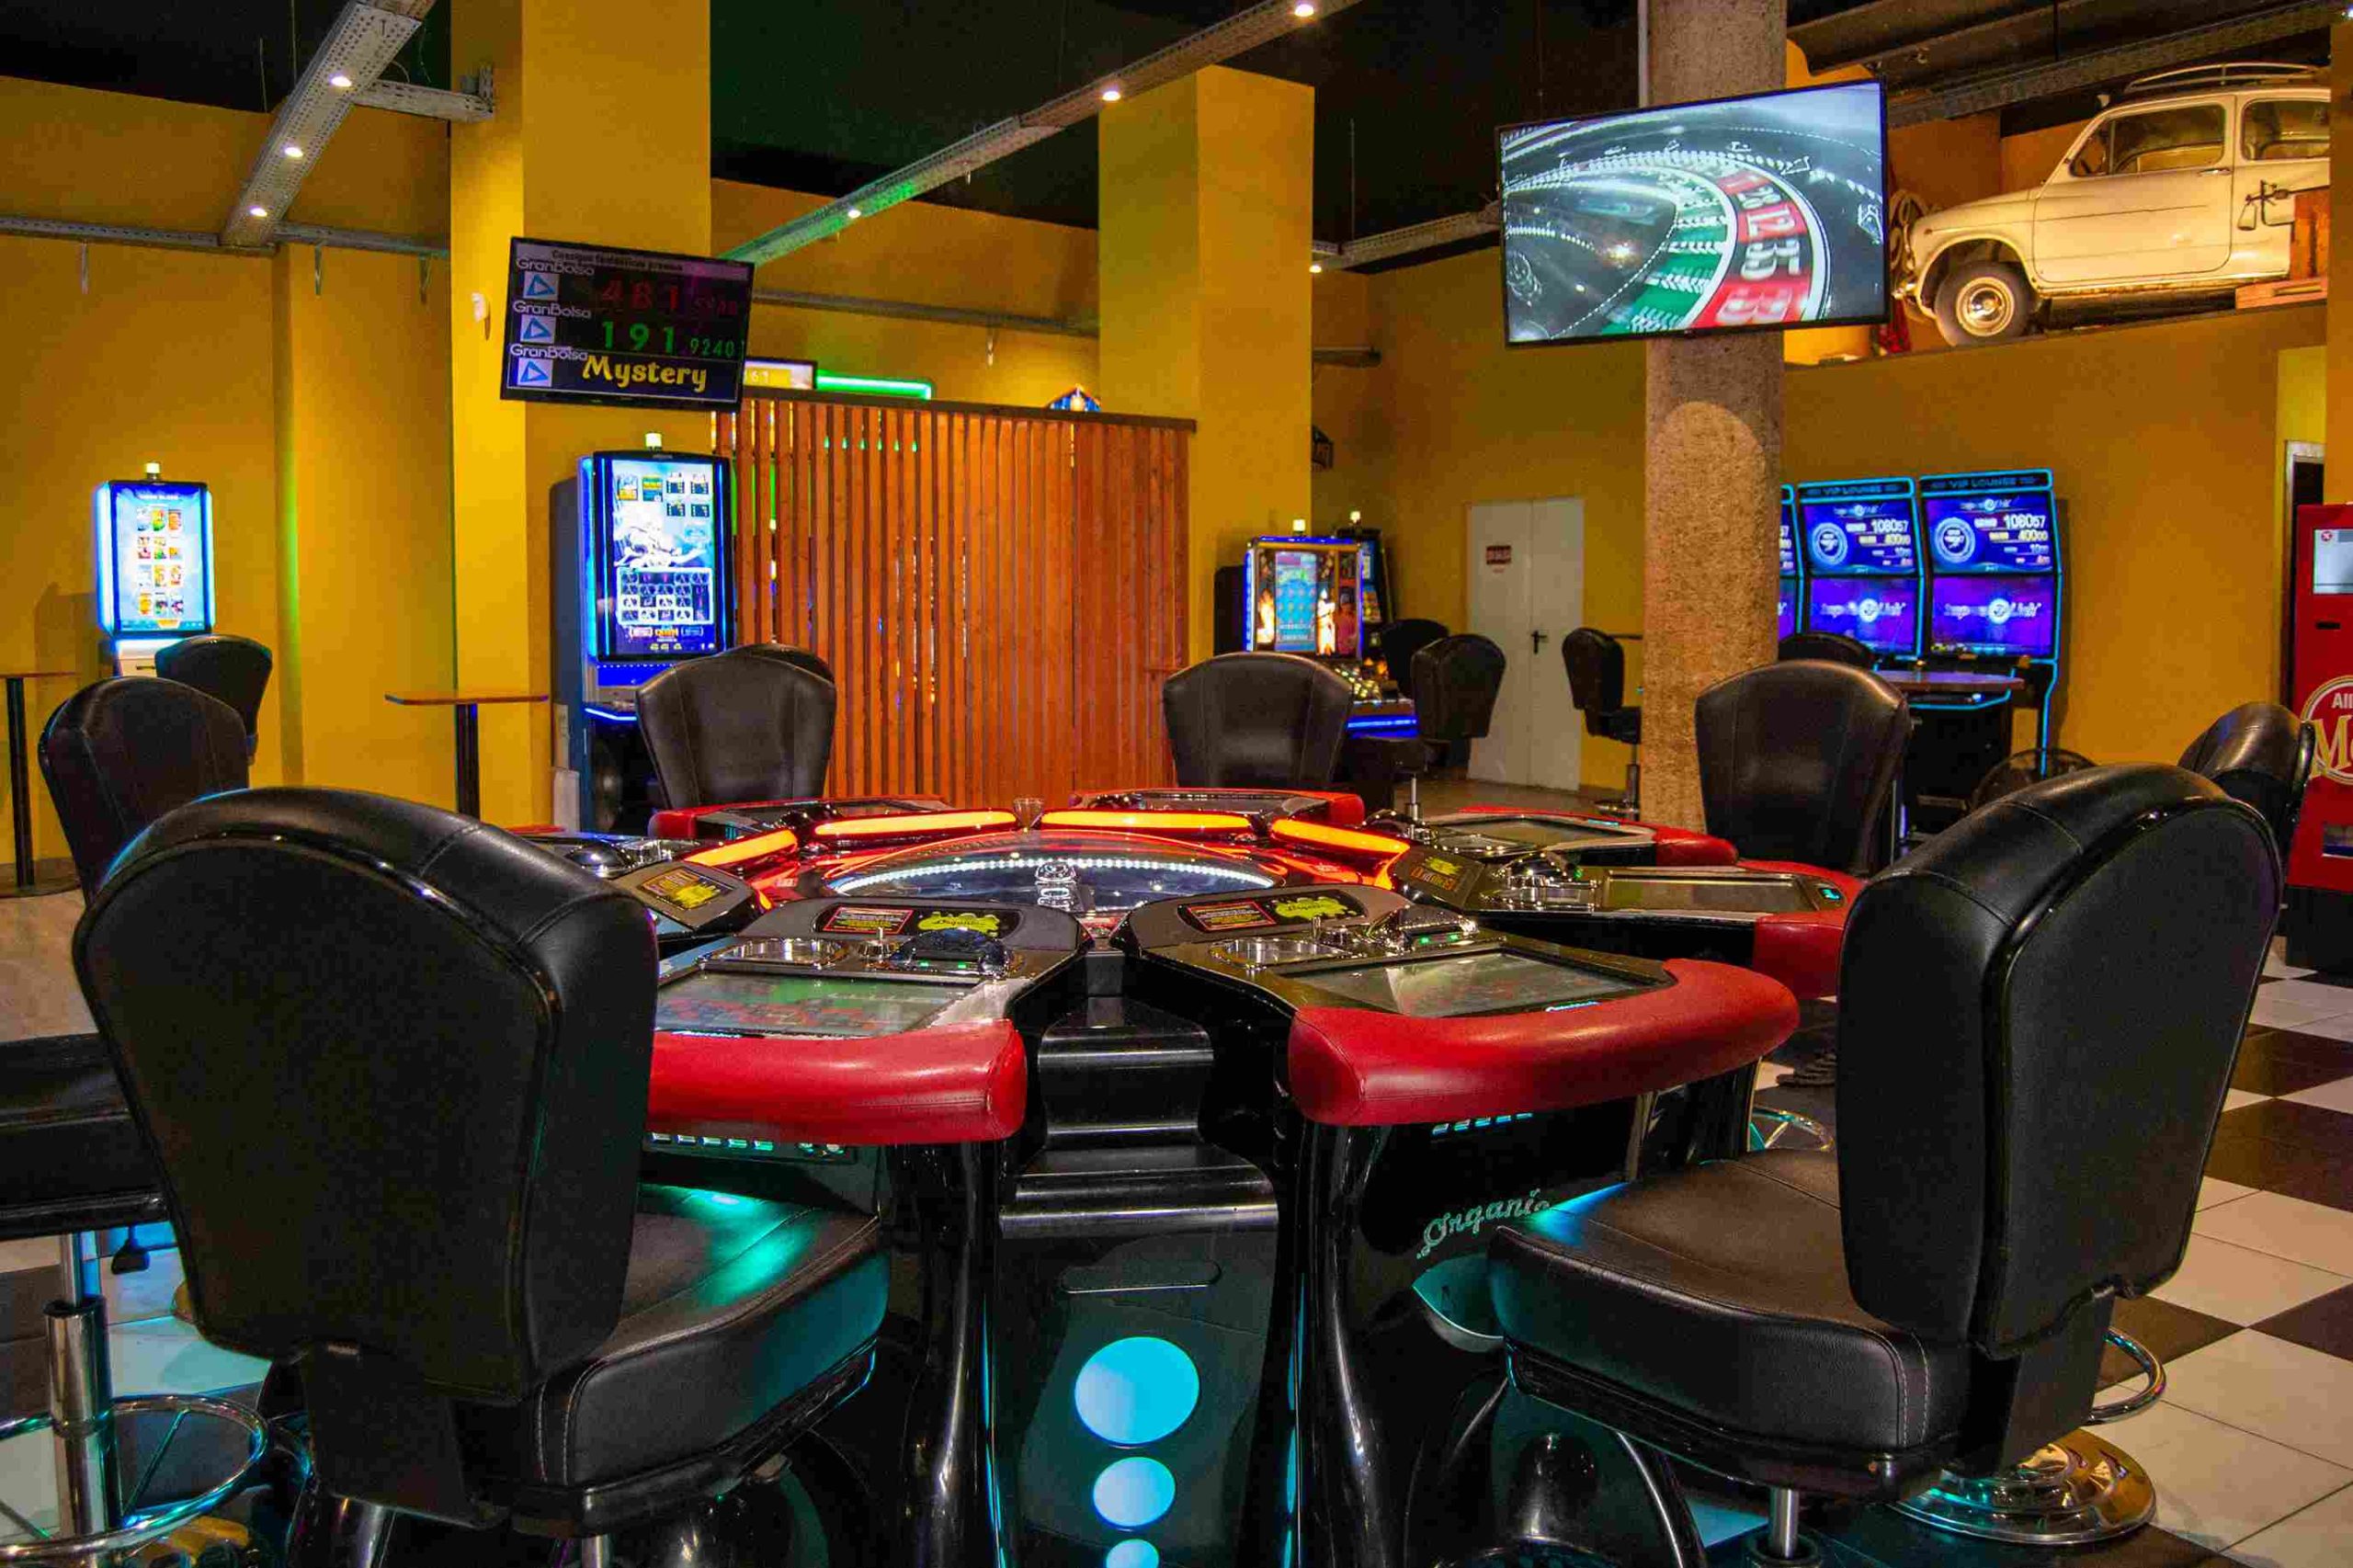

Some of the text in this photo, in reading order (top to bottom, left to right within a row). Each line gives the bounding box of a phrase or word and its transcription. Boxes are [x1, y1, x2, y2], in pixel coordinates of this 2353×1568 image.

[1747, 203, 1795, 237] 12
[517, 257, 595, 275] GranBolsa
[513, 300, 591, 318] GranBolsa
[510, 343, 588, 360] GranBolsa
[602, 322, 676, 354] 191
[582, 355, 708, 393] Mystery
[2310, 715, 2353, 778] M
